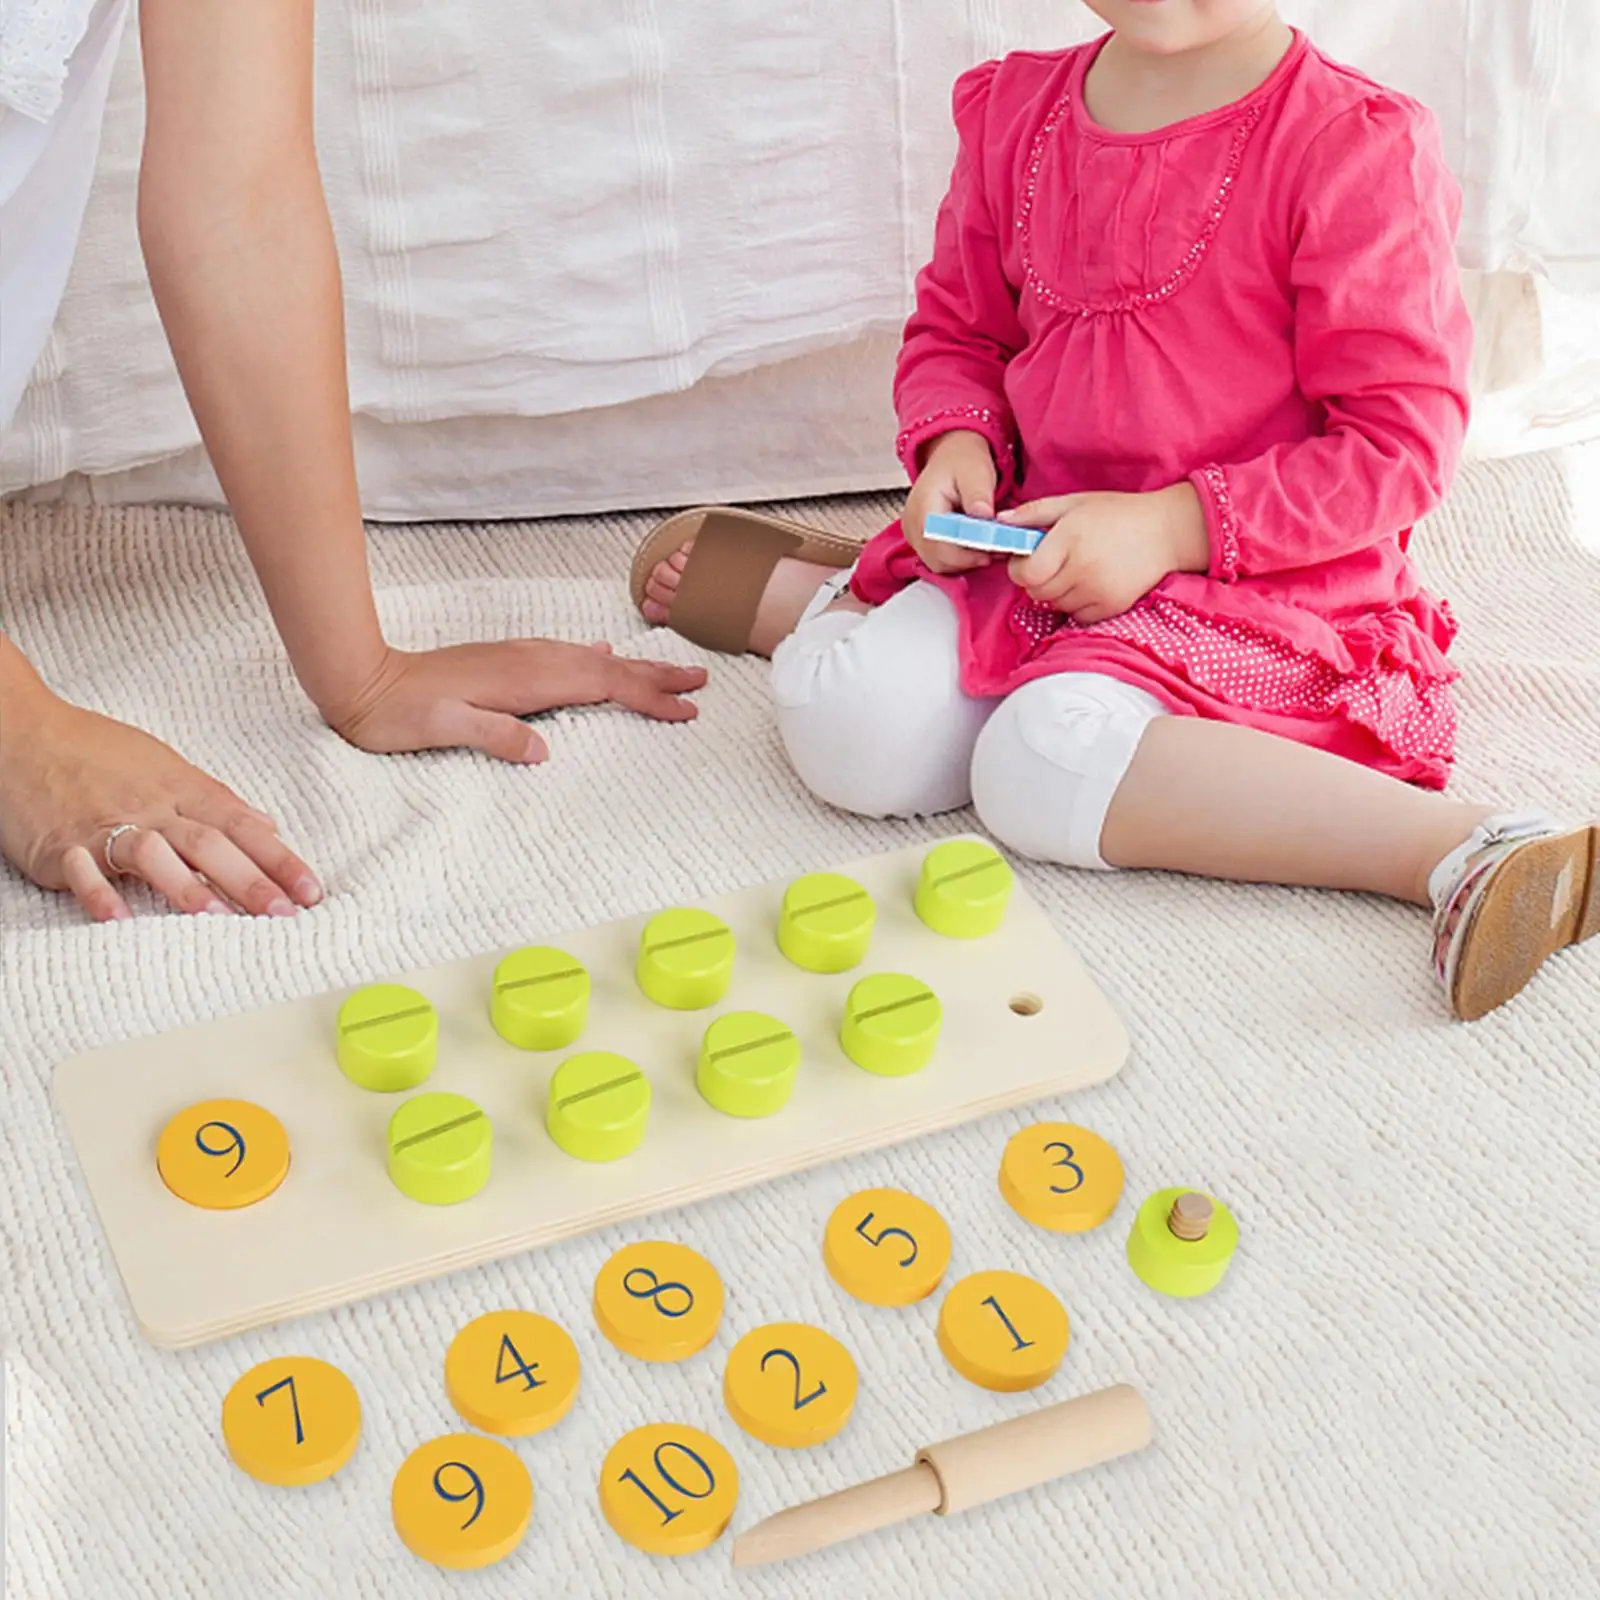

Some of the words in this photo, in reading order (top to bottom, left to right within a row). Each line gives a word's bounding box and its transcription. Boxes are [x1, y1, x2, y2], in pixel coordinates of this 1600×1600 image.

[195, 1121, 246, 1176] 9
[1043, 1141, 1085, 1194] 3
[855, 1212, 918, 1268] 5
[623, 1267, 694, 1318] 8
[981, 1295, 1034, 1352] 1
[494, 1333, 547, 1393] 4
[760, 1348, 827, 1410] 2
[255, 1375, 306, 1445] 7
[432, 1461, 486, 1531] 9
[618, 1441, 716, 1526] 10
